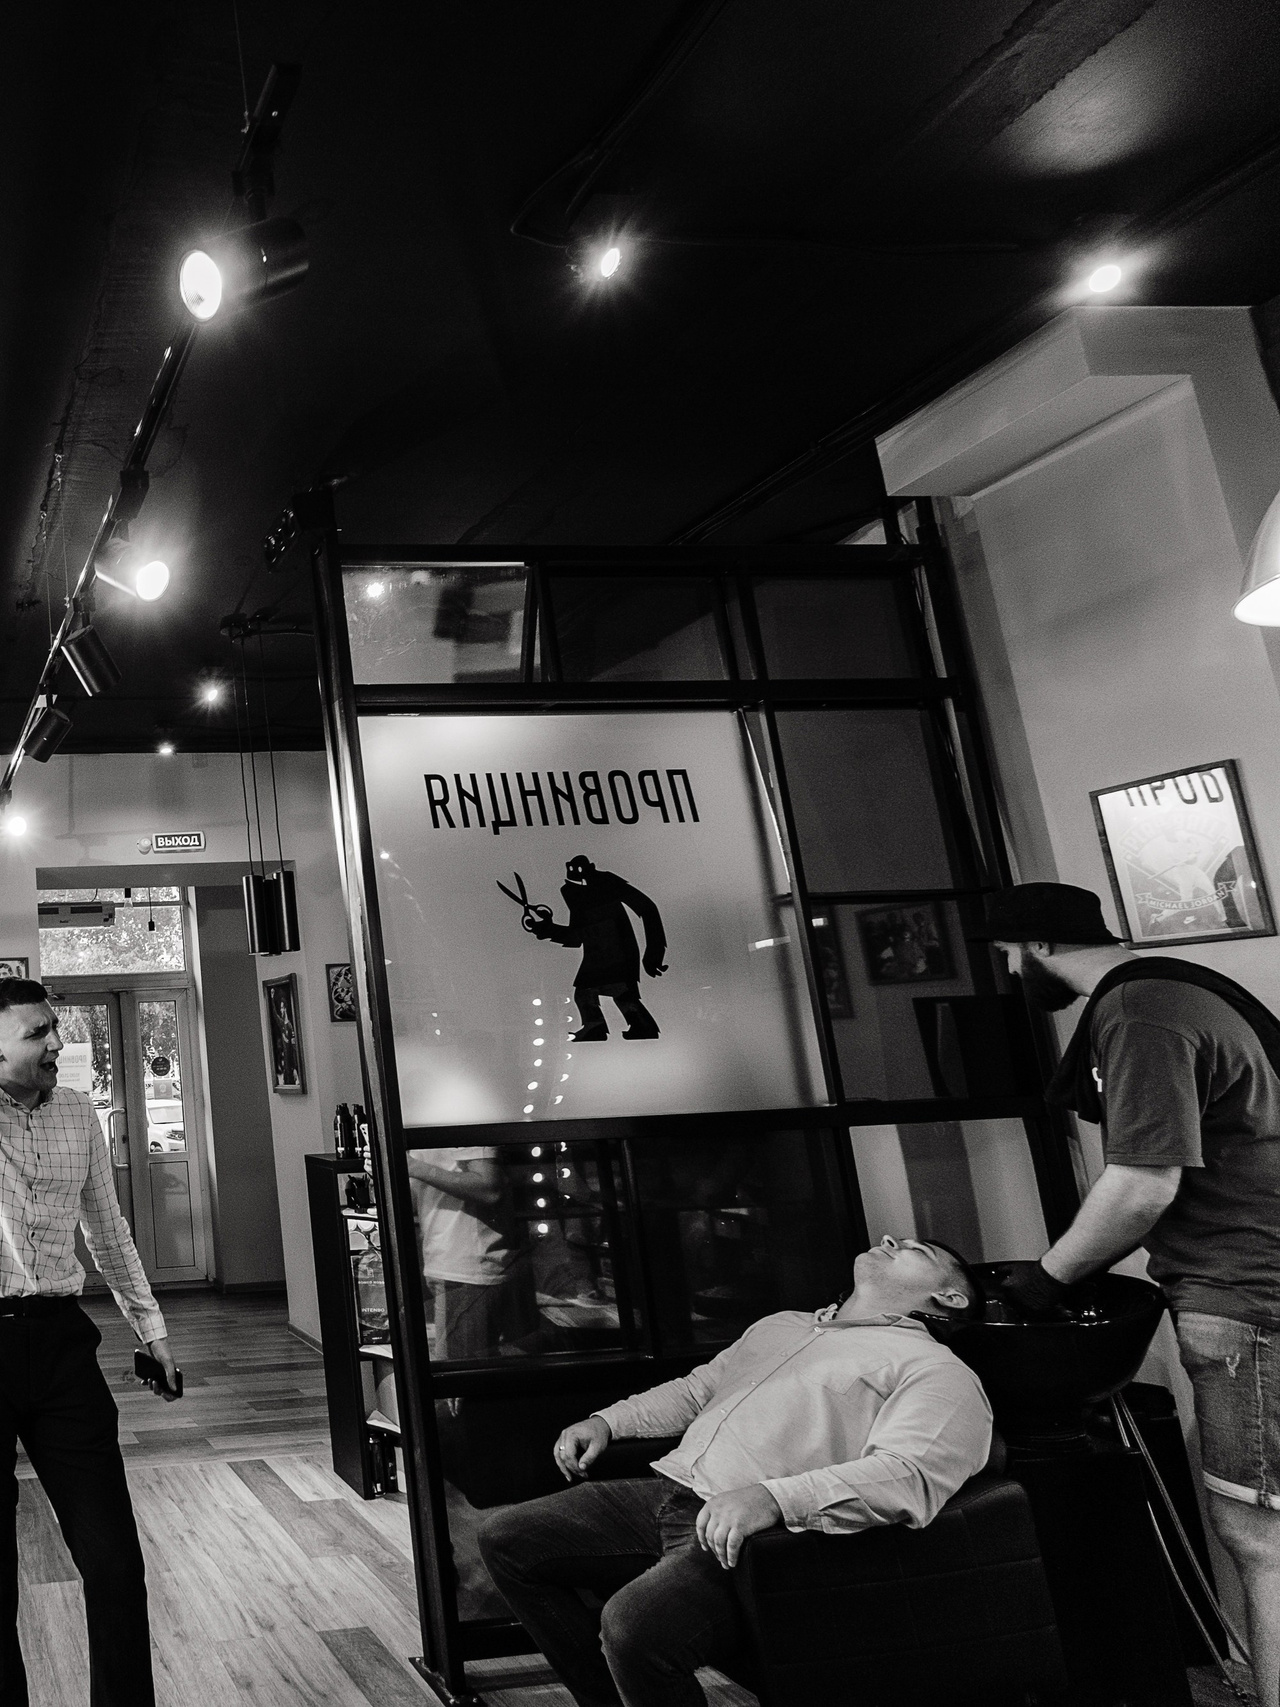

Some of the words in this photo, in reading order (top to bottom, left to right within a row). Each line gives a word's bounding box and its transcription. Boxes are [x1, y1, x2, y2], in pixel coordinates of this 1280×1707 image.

[157, 836, 200, 847] ВЫХОД
[1149, 900, 1190, 910] MICHAEL
[1190, 890, 1226, 908] JORDAN
